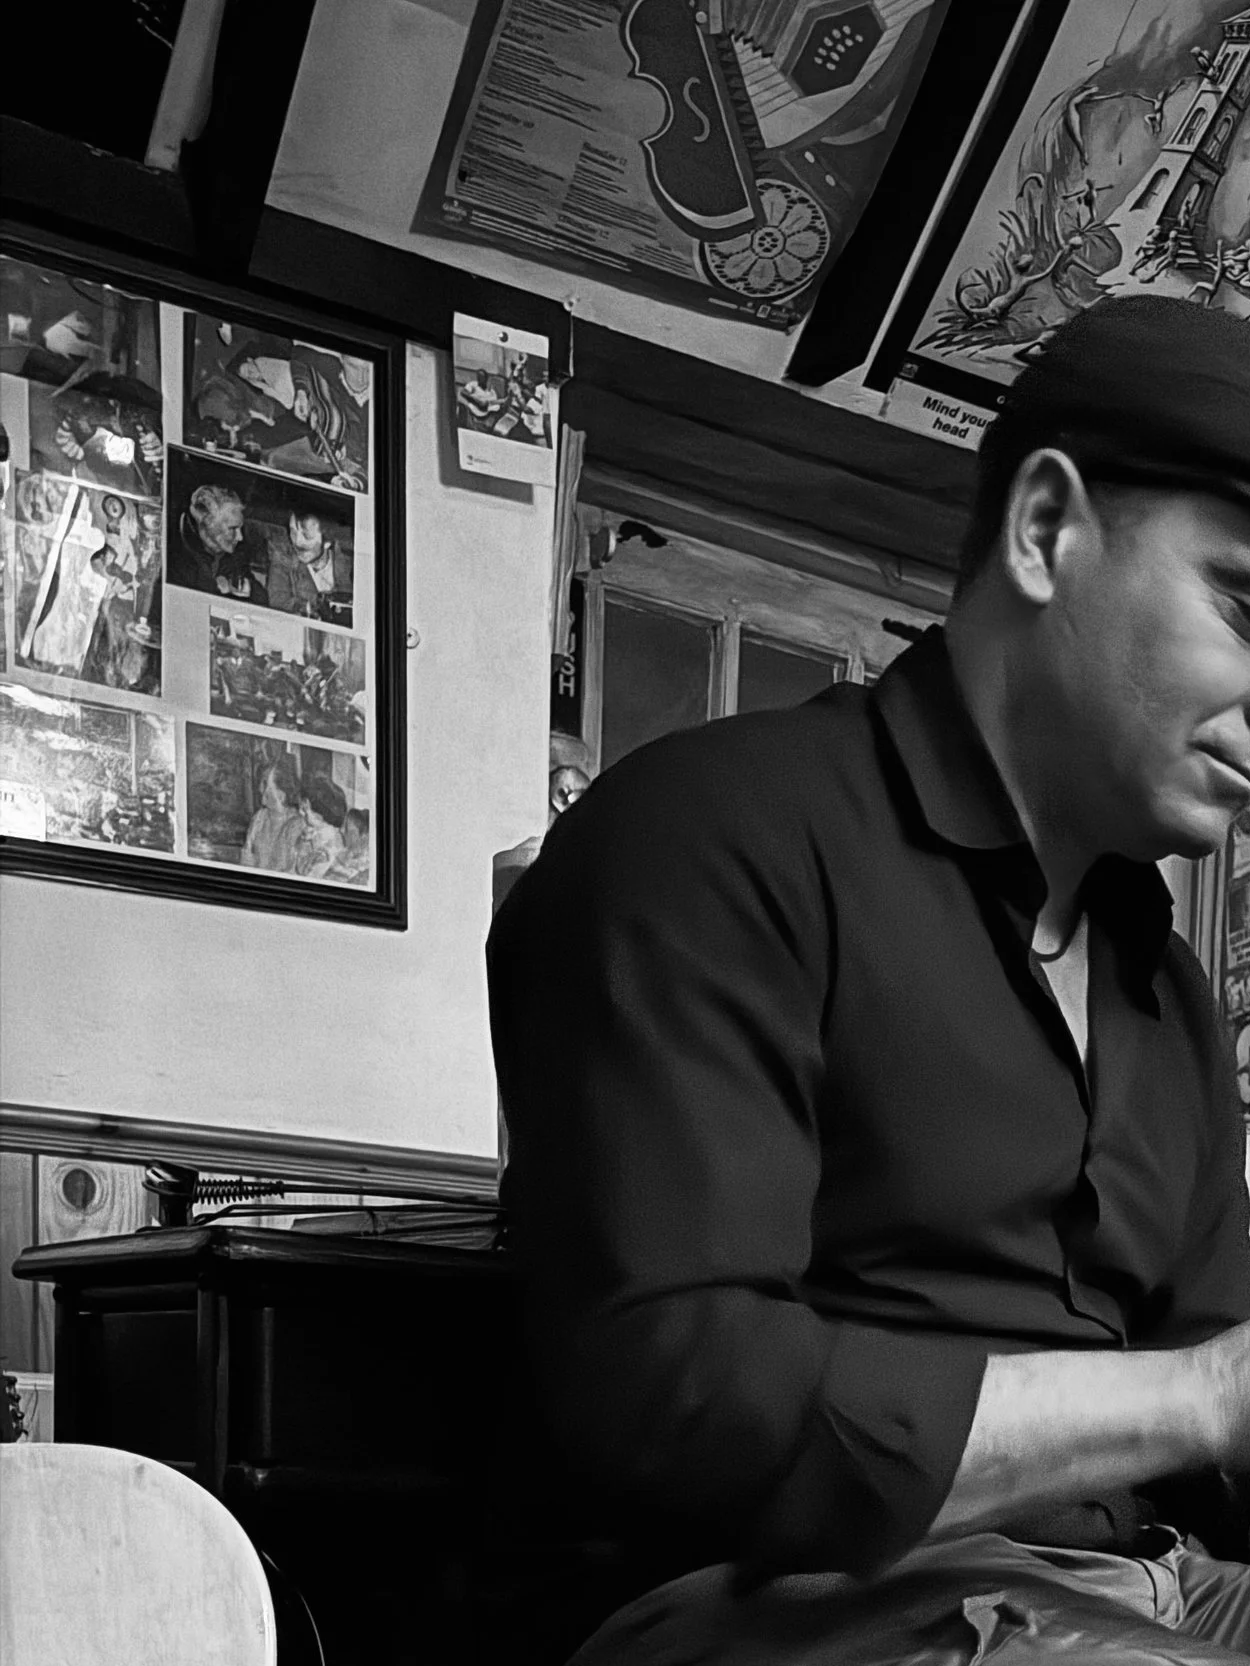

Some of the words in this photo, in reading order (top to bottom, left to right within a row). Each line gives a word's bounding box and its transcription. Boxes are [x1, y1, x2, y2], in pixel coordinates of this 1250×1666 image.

[923, 396, 961, 419] Mind
[959, 410, 989, 429] you
[932, 417, 970, 439] head
